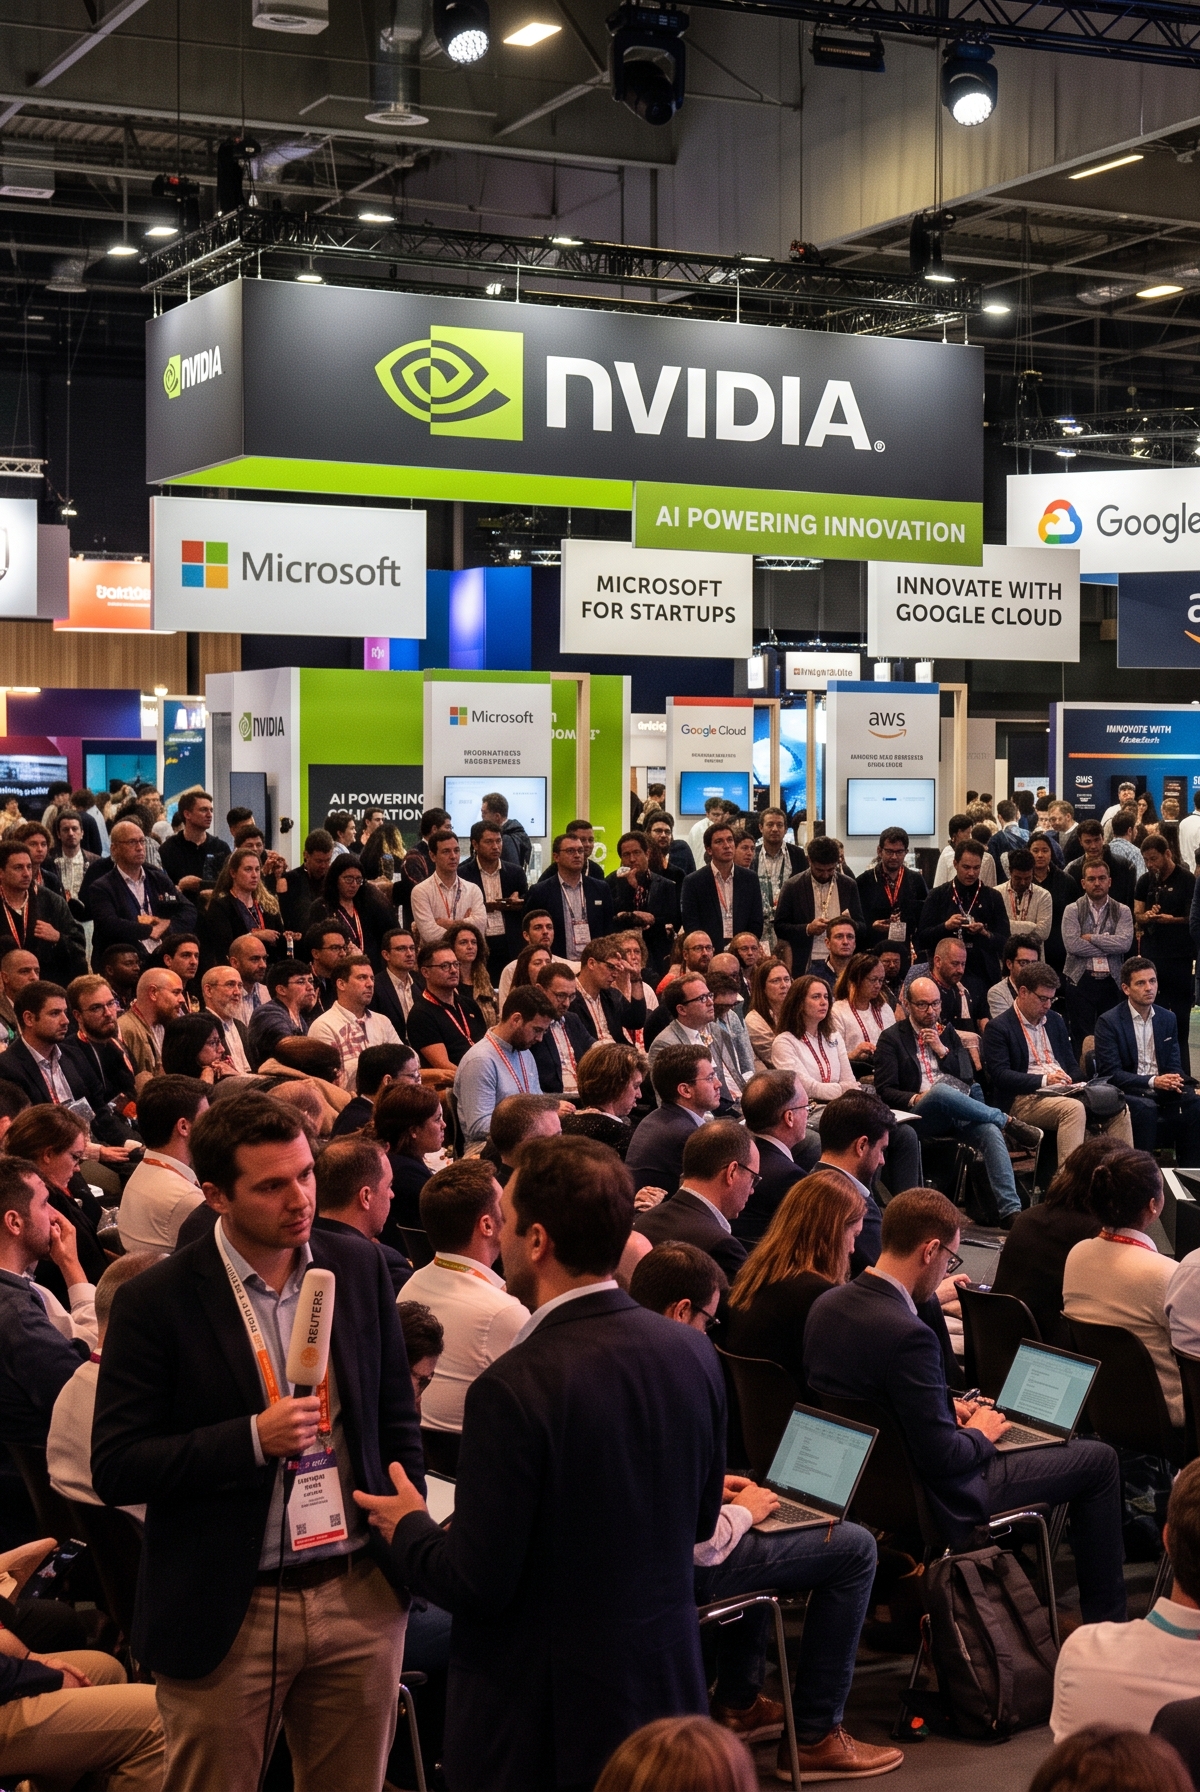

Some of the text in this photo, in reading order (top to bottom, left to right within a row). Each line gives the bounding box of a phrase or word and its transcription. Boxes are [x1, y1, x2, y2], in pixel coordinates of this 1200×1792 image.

[182, 345, 222, 389] NVIDIA
[546, 355, 872, 450] NVIDIA
[656, 505, 966, 543] AI POWERING INNOVATION
[241, 551, 401, 587] Microsoft
[597, 575, 722, 597] MICROSOFT
[897, 576, 1062, 600] INNOVATE WITH
[582, 601, 736, 623] FOR STARTUPS
[896, 603, 1062, 626] GOOGLE CLOUD
[253, 715, 285, 738] NVIDIA
[471, 710, 533, 724] Microsoft
[868, 711, 905, 727] aws
[681, 724, 717, 737] Google
[718, 725, 747, 736] Cloud
[1150, 725, 1172, 734] WITH
[329, 793, 345, 804] AI
